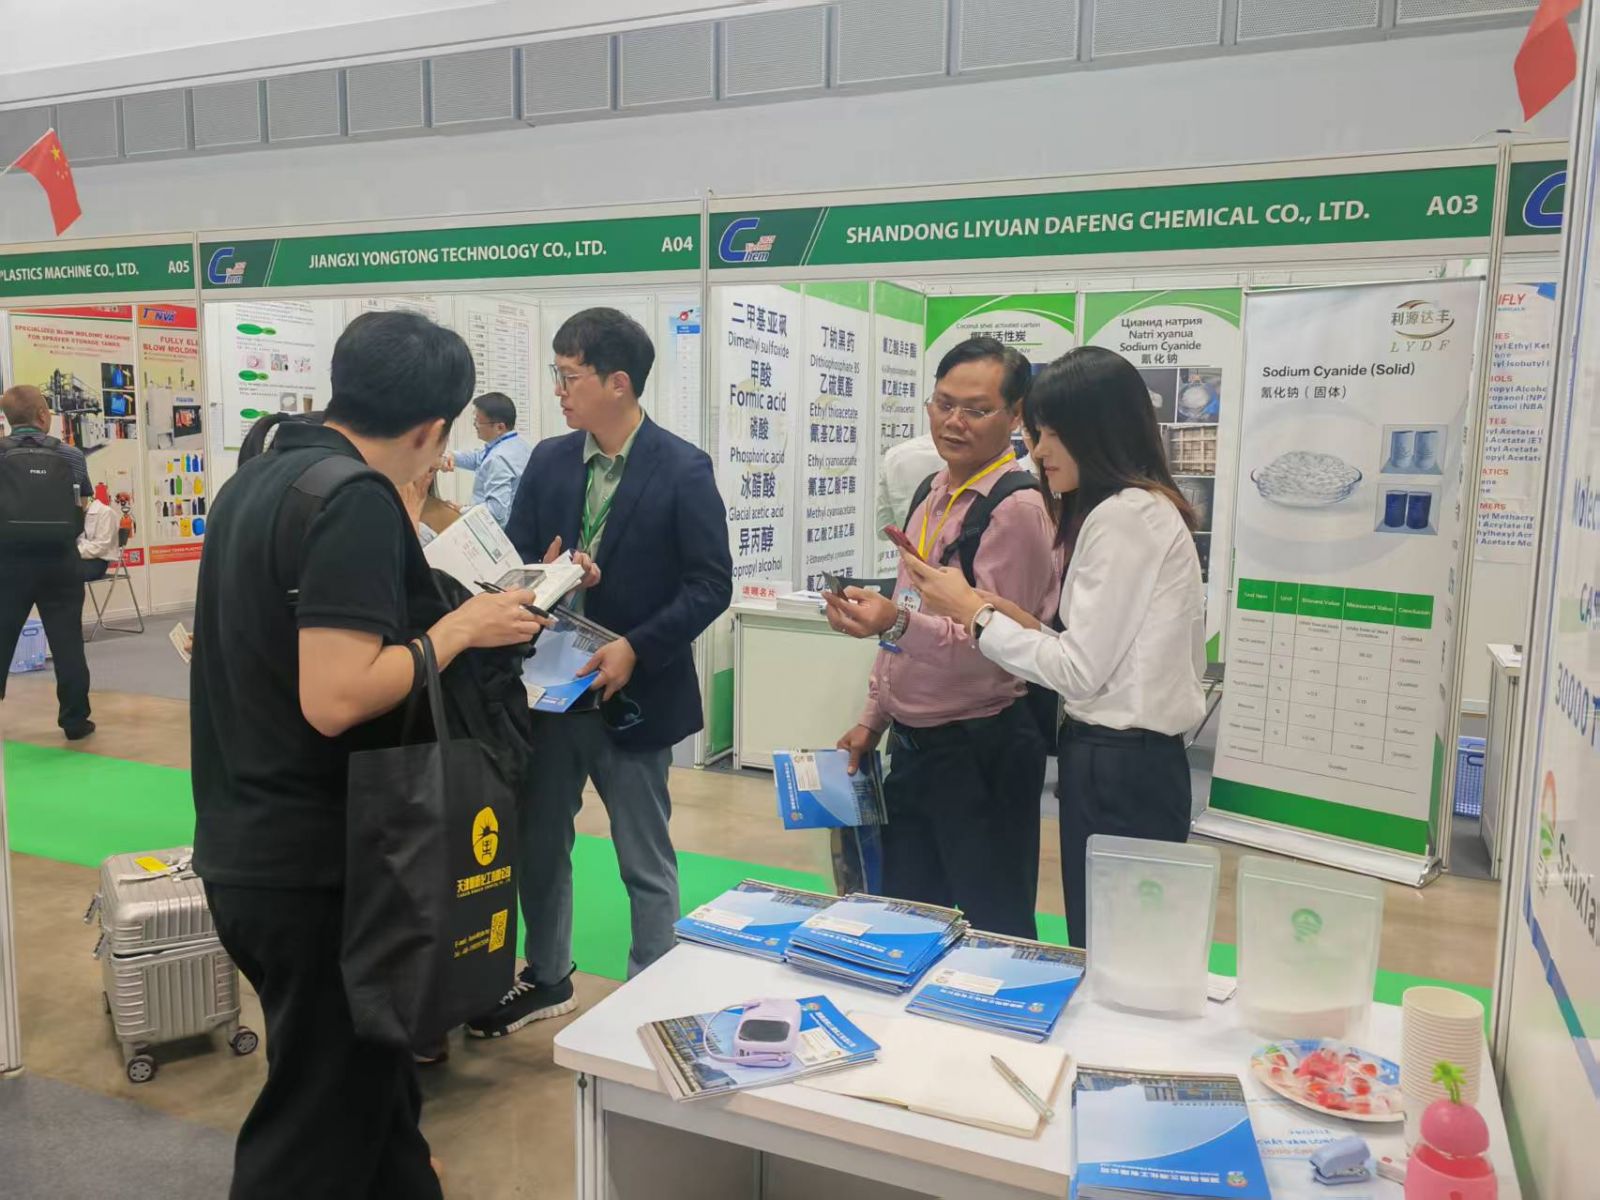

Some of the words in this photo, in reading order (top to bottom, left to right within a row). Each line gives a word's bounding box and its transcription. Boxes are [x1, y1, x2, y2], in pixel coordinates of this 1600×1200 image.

[1426, 194, 1479, 217] A03
[846, 221, 958, 244] SHANDONG
[963, 217, 1039, 239] LIYUAN
[1045, 212, 1134, 235] DAFENG
[1139, 203, 1259, 230] CHEMICAL
[1265, 203, 1312, 225] CO.,
[1317, 200, 1370, 221] LTD.
[661, 236, 694, 252] A04
[308, 251, 359, 269] JIANGXI
[363, 248, 438, 267] YONGTONG
[441, 243, 538, 264] TECHNOLOGY
[543, 242, 572, 259] CO.,
[575, 240, 607, 256] LTD.
[45, 265, 92, 280] MACHINE
[94, 263, 115, 278] CO.,
[117, 262, 139, 276] LTD.
[168, 260, 190, 274] A05
[1121, 318, 1163, 329] Цианид
[1165, 318, 1203, 327] натрия
[1390, 309, 1450, 326] 利源达丰
[160, 336, 184, 344] FULLY
[1129, 329, 1154, 339] Natri
[1156, 330, 1194, 341] xyanua
[143, 343, 166, 352] BLOW
[728, 331, 760, 355] Dimethyl
[761, 340, 789, 358] sulfoxide
[1120, 342, 1158, 352] Sodium
[1160, 340, 1202, 352] Cyanide
[1508, 342, 1532, 352] Ethyl
[751, 360, 772, 388] 甲酸
[1262, 365, 1310, 377] Sodium
[1313, 364, 1368, 379] Cyanide
[1370, 361, 1415, 377] (Solid)
[730, 384, 764, 409] Formic
[767, 391, 787, 412] acid
[809, 402, 828, 420] Ethyl
[750, 416, 769, 440] 磷酸
[730, 446, 769, 466] Phosphoric
[770, 450, 785, 464] acid
[1503, 445, 1538, 453] Acetate
[808, 454, 824, 470] Ethyl
[740, 471, 776, 499] 冰醋酸
[729, 506, 751, 521] Glacial
[752, 505, 769, 519] acetic
[771, 504, 784, 518] acid
[806, 506, 826, 520] Methyl
[739, 523, 774, 556] 异丙醇
[1481, 538, 1516, 546] Acetate
[758, 556, 783, 573] alcohol
[1555, 661, 1589, 737] 30000
